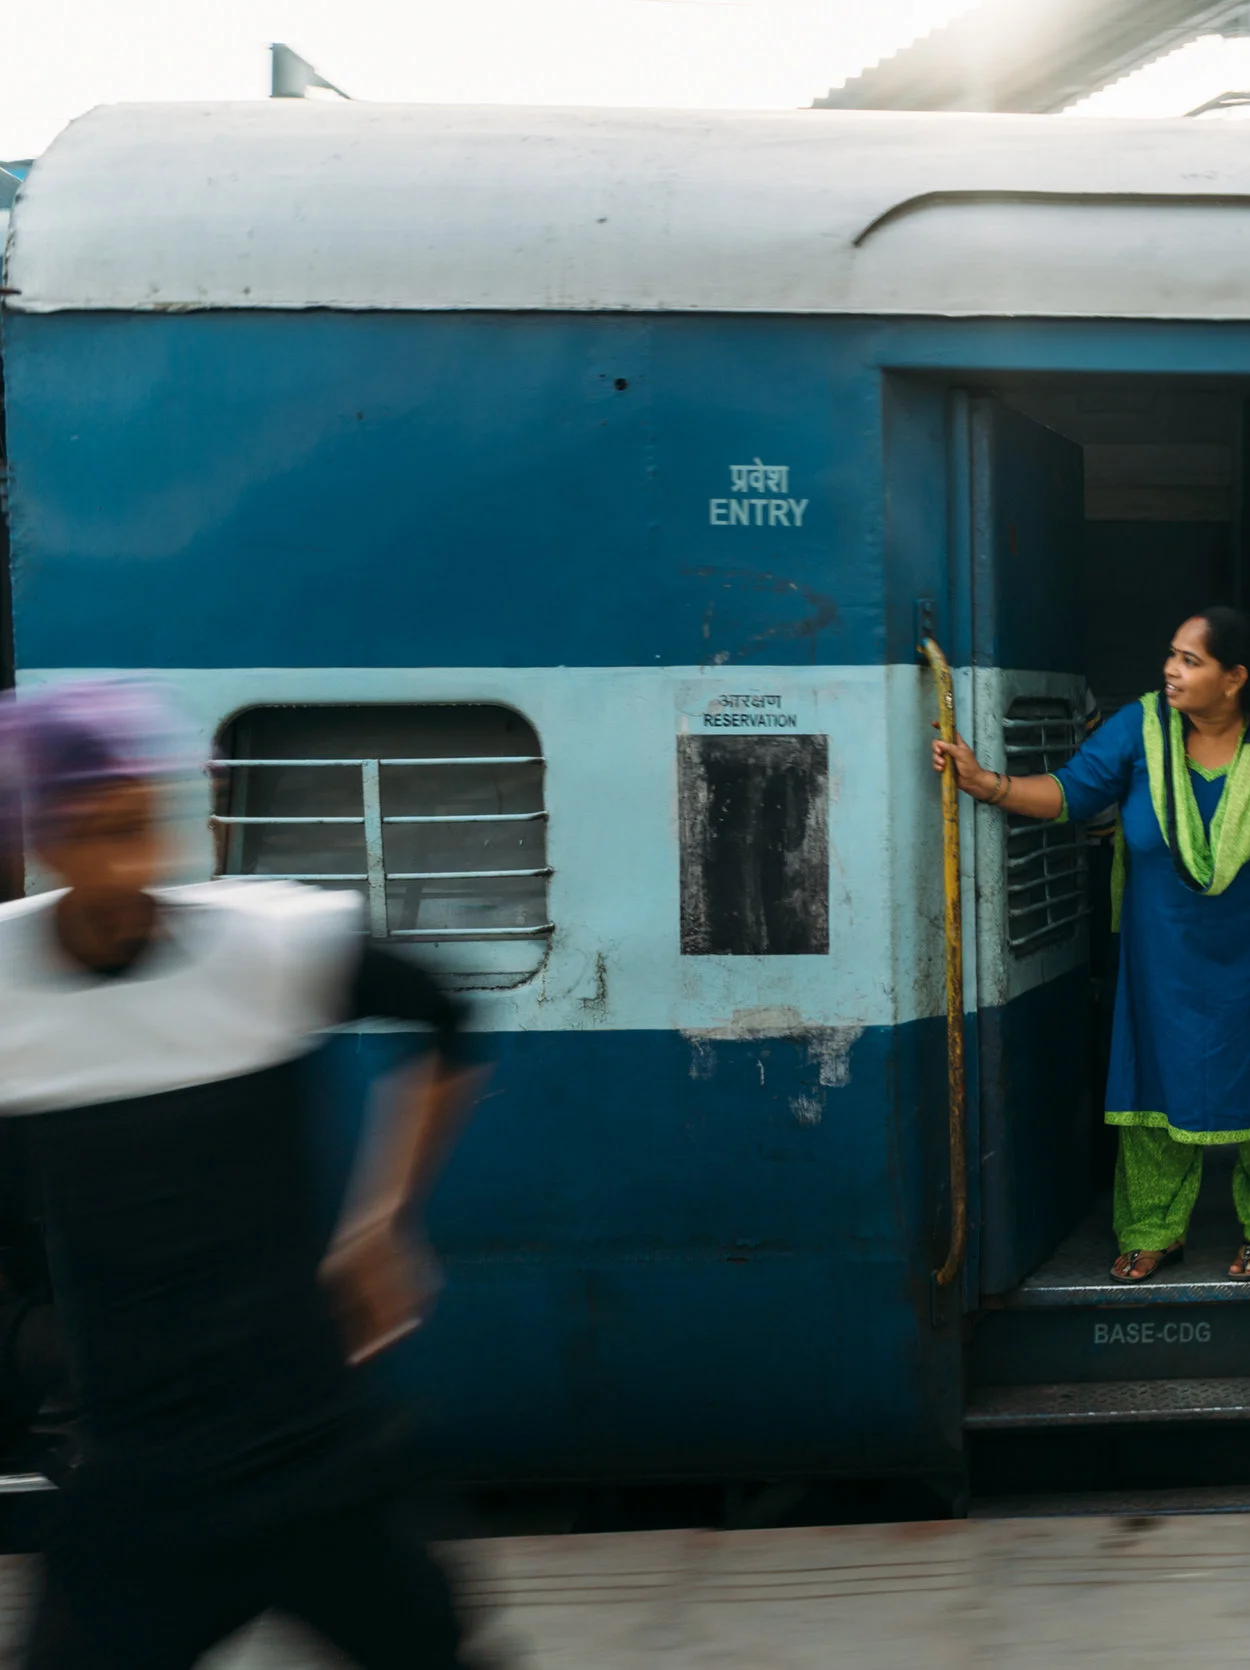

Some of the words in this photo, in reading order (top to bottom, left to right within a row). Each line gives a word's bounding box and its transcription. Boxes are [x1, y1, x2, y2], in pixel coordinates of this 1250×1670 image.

[729, 457, 790, 493] प्रवेश
[709, 498, 809, 526] ENTRY
[718, 694, 782, 709] आरक्षण
[702, 713, 797, 728] RESERVATION
[1094, 1321, 1211, 1344] BASE-CDG
